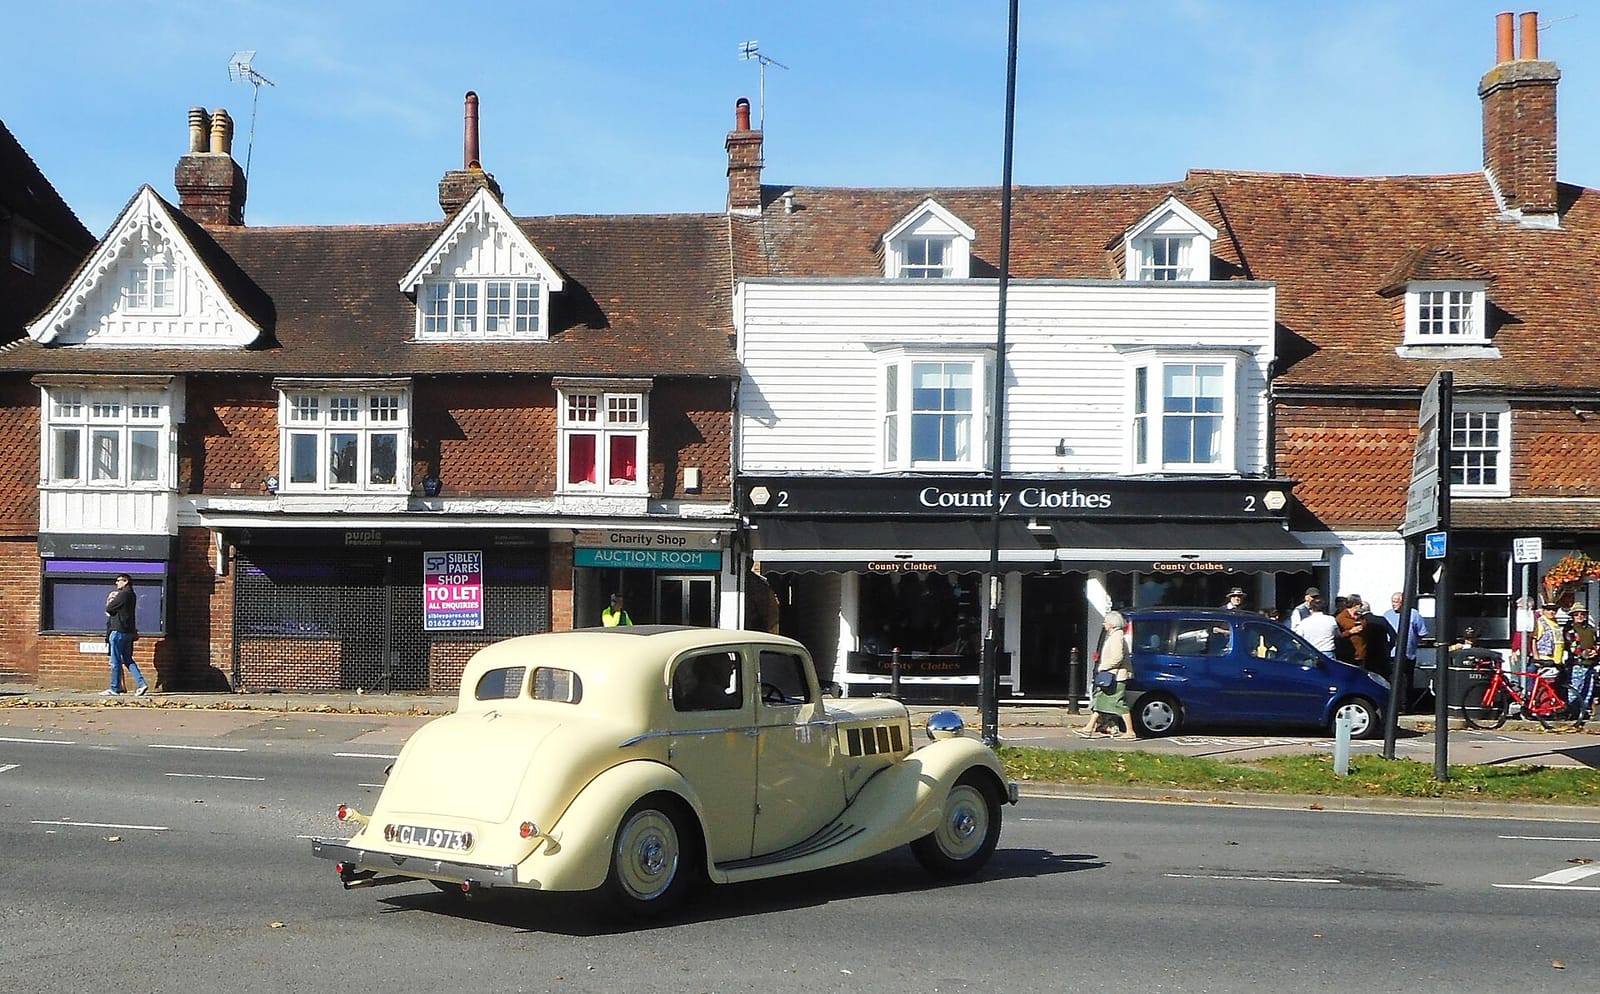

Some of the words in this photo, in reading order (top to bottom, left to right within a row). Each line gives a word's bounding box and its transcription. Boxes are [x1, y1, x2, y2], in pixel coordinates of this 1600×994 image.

[777, 492, 789, 507] 2
[919, 487, 1012, 512] County
[1019, 487, 1112, 508] Clothes
[1244, 496, 1256, 511] 2
[610, 533, 652, 545] Charity
[656, 535, 686, 547] Shop
[448, 553, 479, 563] SIBLEY
[594, 551, 656, 562] AUCTION
[661, 552, 702, 564] ROOM
[448, 563, 480, 573] PARES
[867, 562, 900, 572] County
[903, 562, 937, 571] Clothes
[1153, 562, 1187, 572] County
[1189, 562, 1224, 571] Clothes
[438, 575, 469, 585] SHOP
[427, 587, 449, 601] TO
[452, 587, 479, 601] LET
[442, 602, 479, 611] ENQUIRIES
[400, 826, 463, 850] CLJ973
